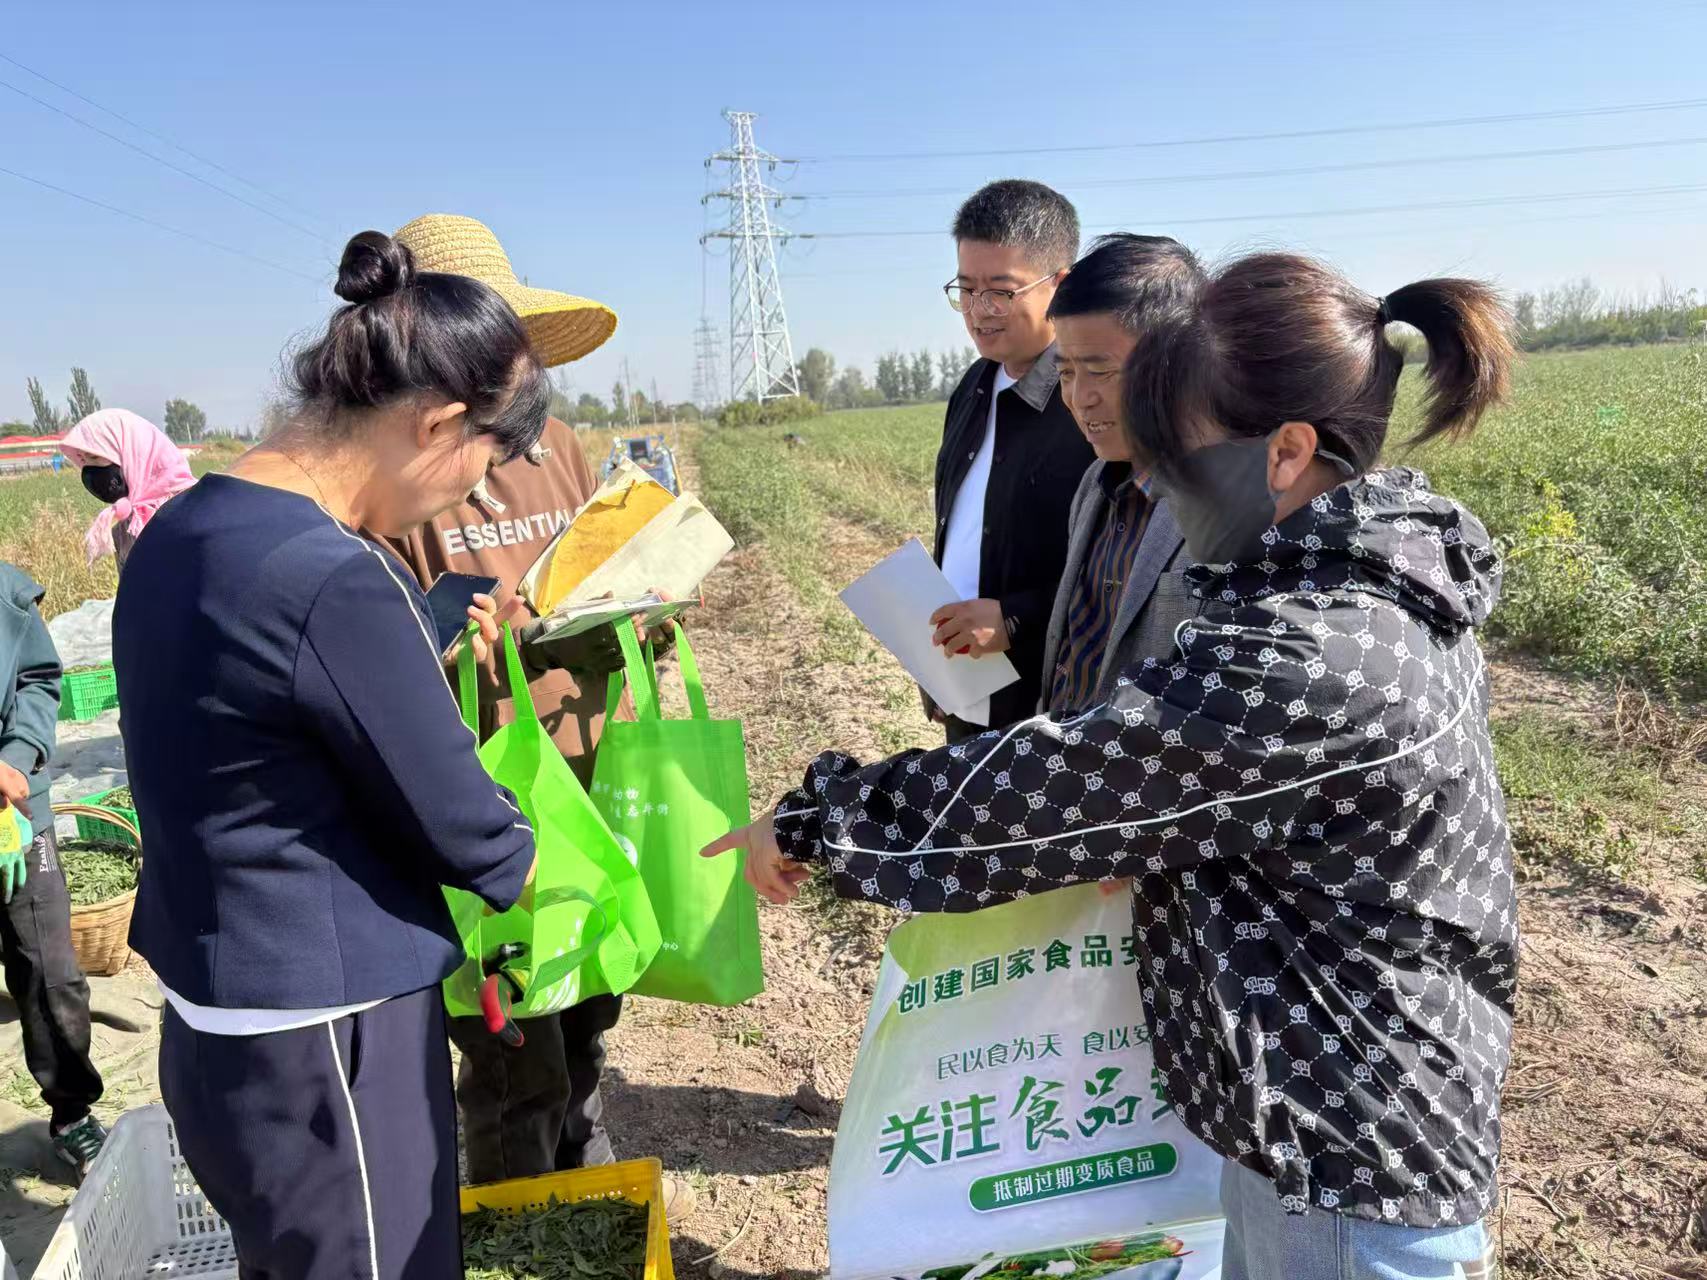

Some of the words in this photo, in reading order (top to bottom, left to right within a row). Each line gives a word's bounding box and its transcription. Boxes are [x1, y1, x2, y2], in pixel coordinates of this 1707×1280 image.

[937, 1033, 1063, 1080] 民以食为天
[992, 1151, 1156, 1203] 抵制过期变质食品
